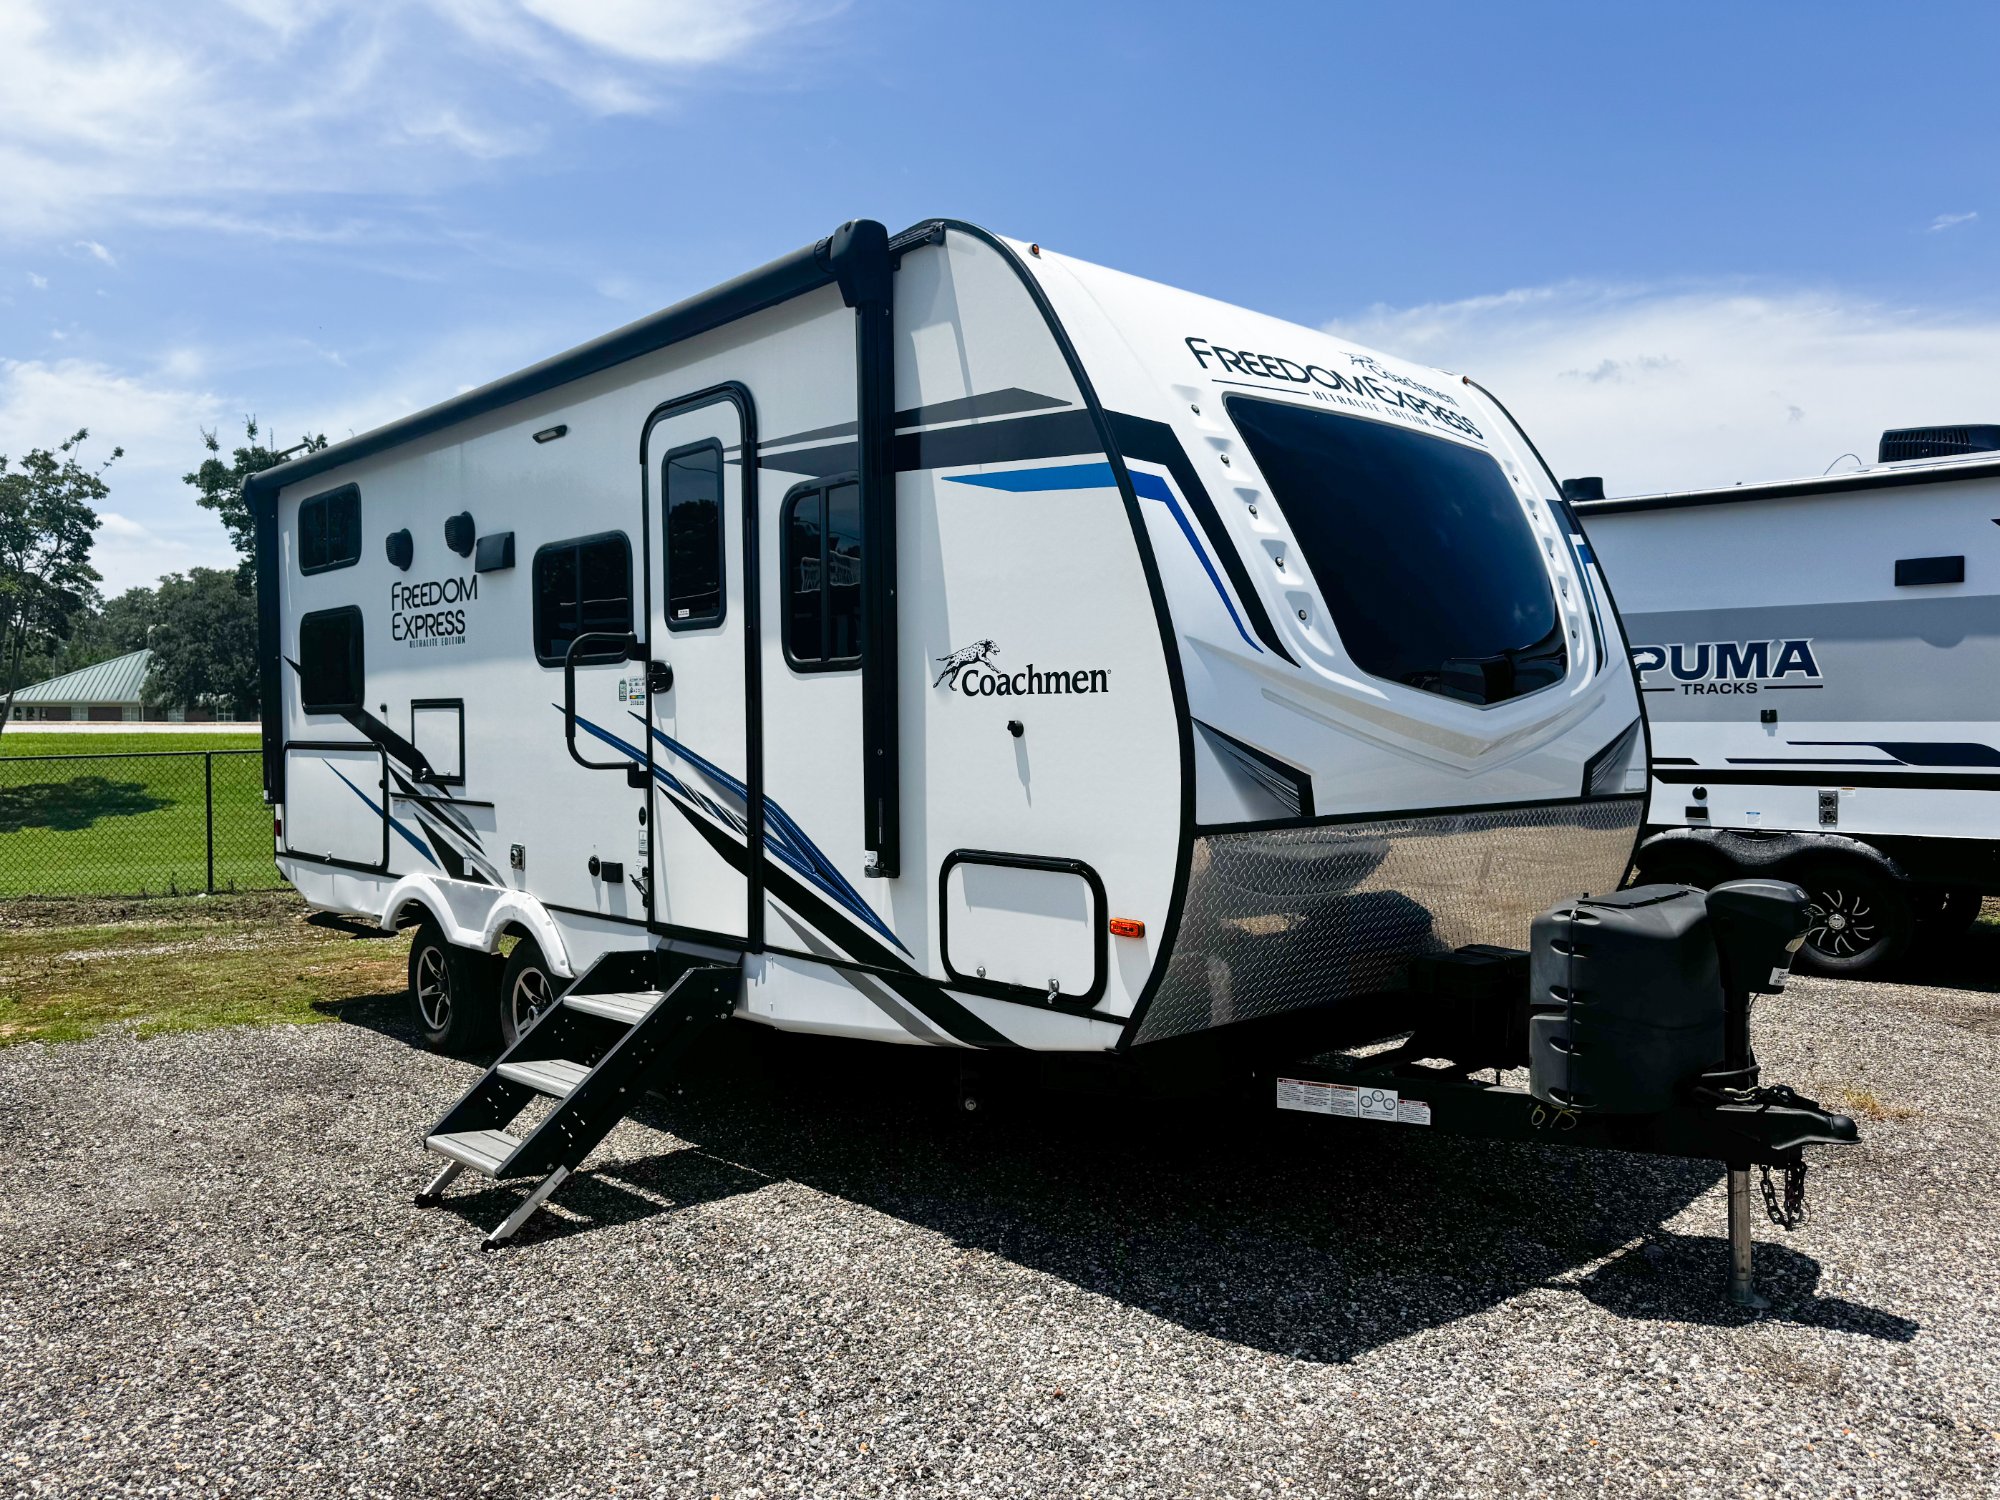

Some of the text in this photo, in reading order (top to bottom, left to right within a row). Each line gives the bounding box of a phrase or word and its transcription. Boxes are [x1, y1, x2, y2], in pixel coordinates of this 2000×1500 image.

[1369, 365, 1460, 407] Coachmen
[1313, 390, 1431, 427] ULTRALITE EDITION
[392, 575, 477, 611] FREEDOM
[392, 610, 465, 641] EXPRESS
[409, 636, 465, 648] ULTRALITE EDITION
[1630, 638, 1823, 682] PUMA
[961, 664, 1109, 697] Coachmen
[1681, 682, 1758, 695] TRACKS
